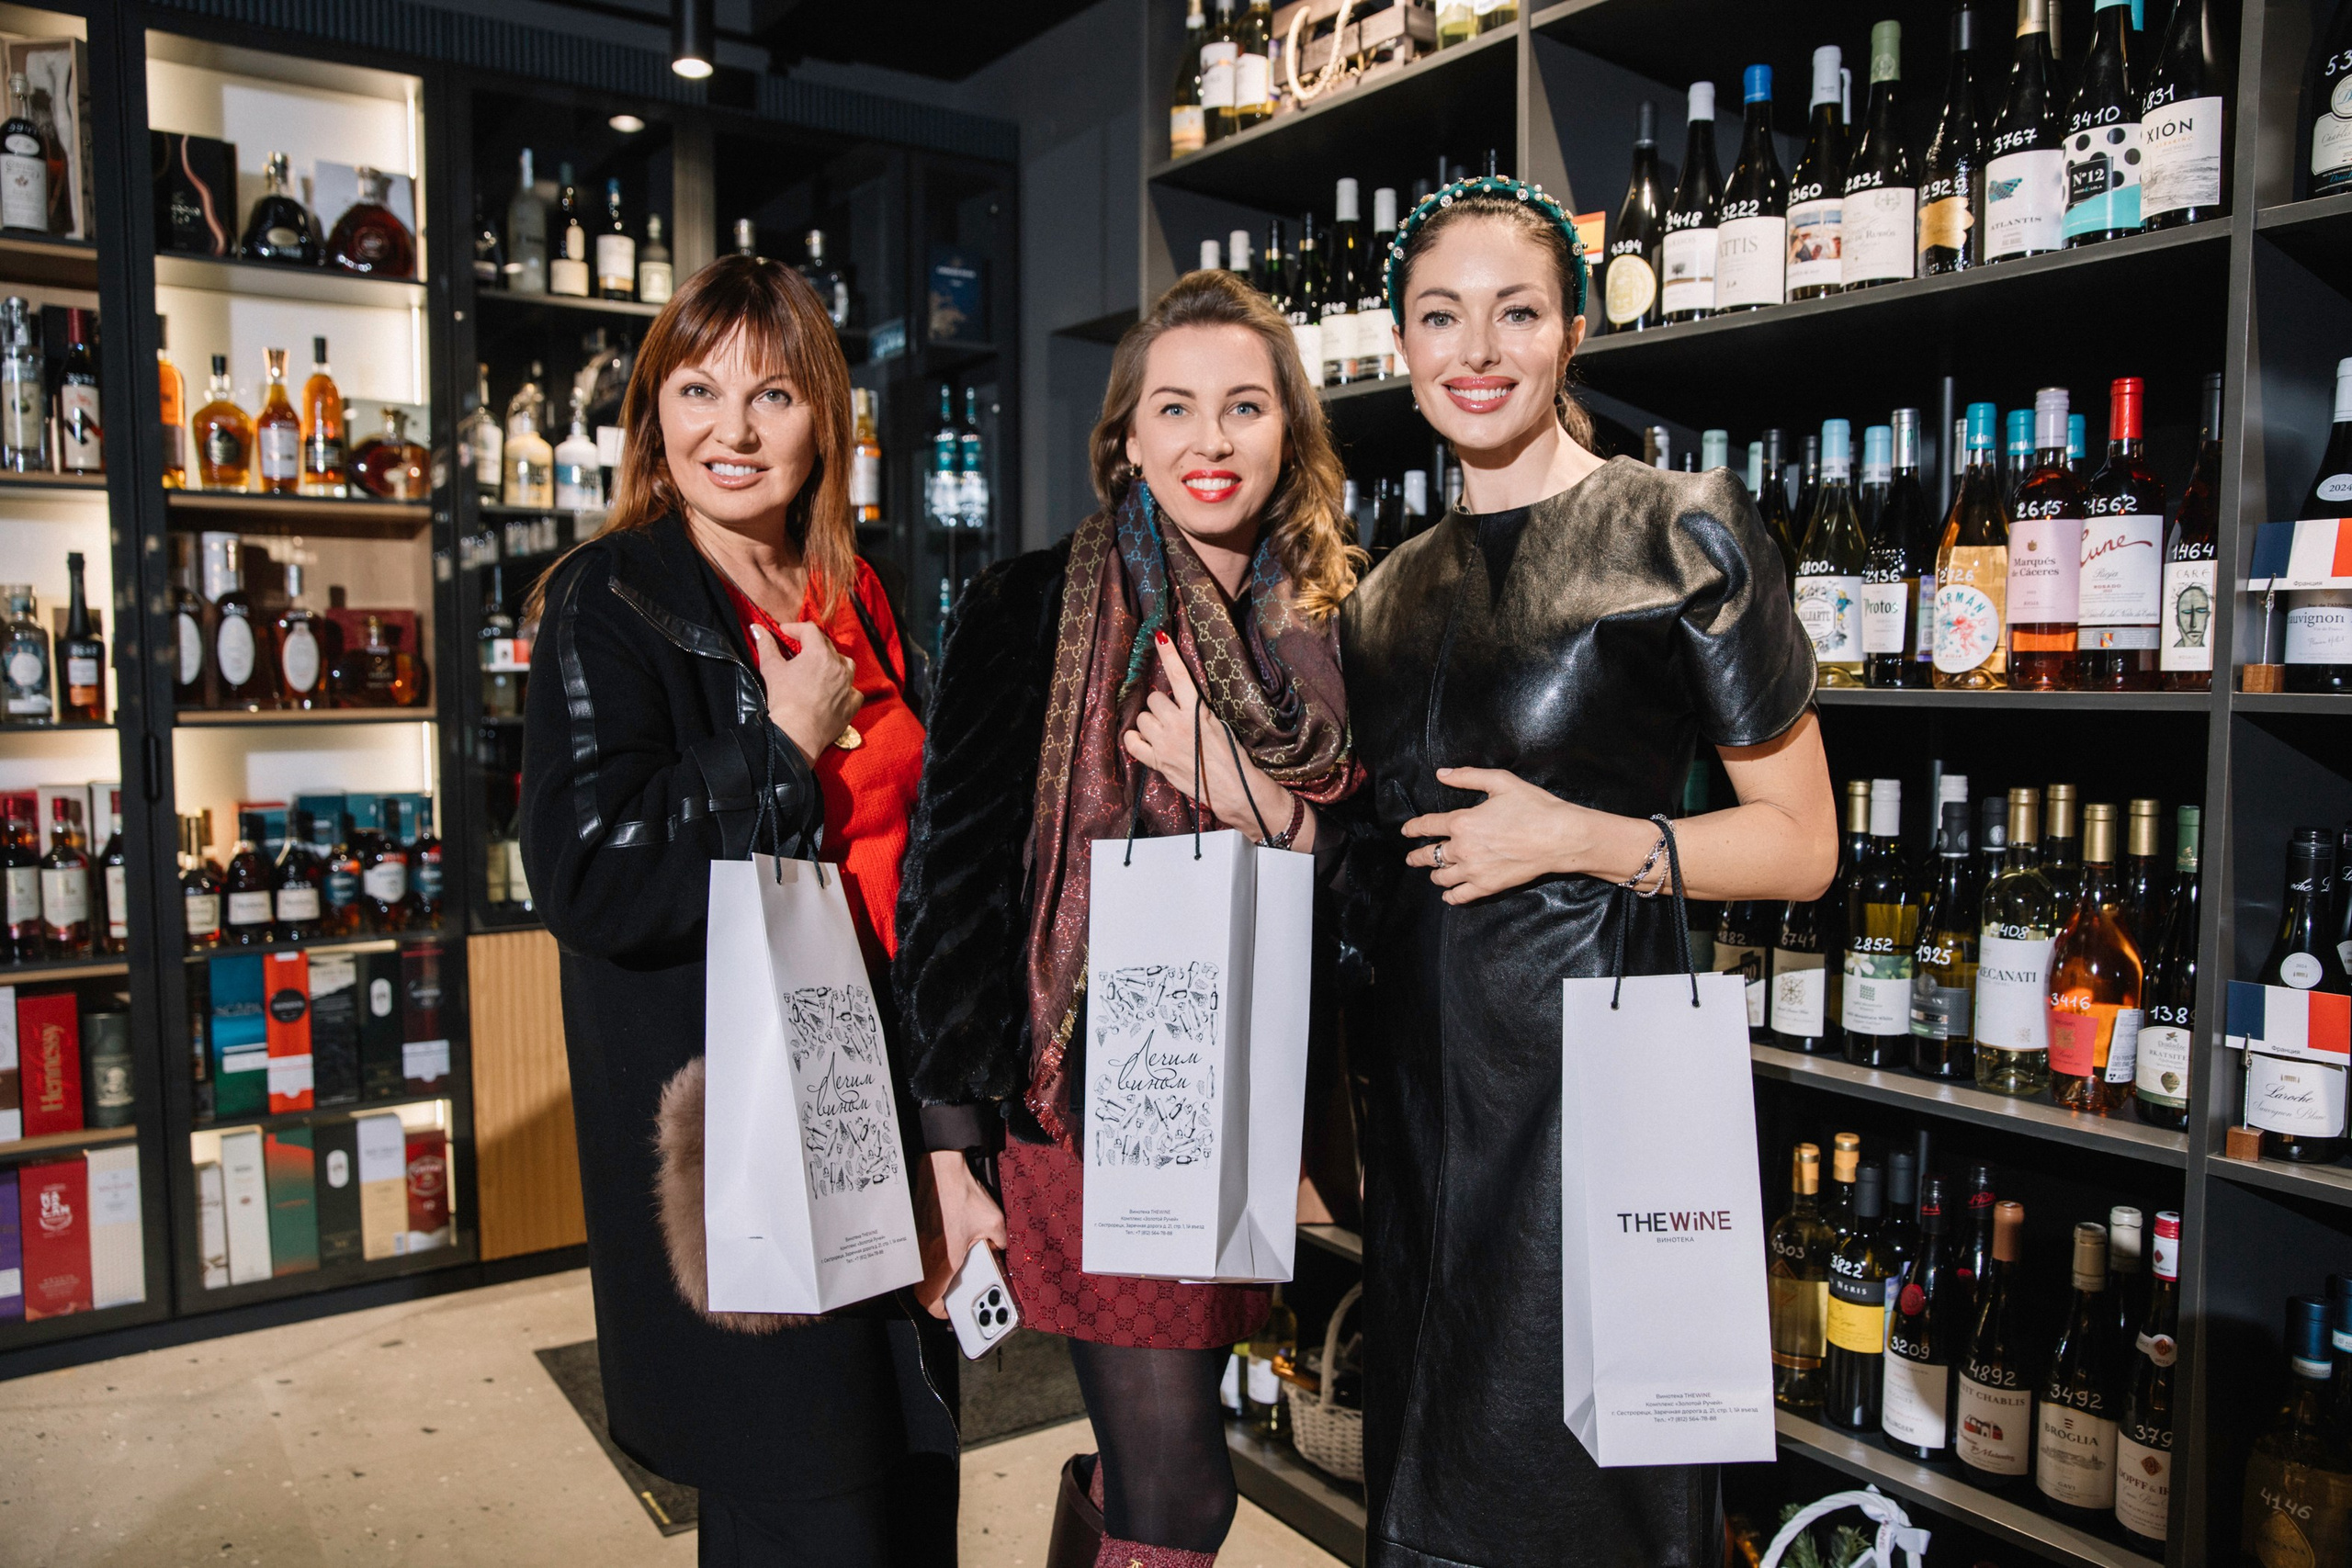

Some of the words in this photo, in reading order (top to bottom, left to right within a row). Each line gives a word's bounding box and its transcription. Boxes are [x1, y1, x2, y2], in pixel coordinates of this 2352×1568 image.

[2069, 106, 2120, 131] 3410
[1993, 128, 2038, 155] 3767
[2146, 118, 2193, 145] XIÓN
[1844, 171, 1883, 194] 2831
[1720, 198, 1759, 222] 3222
[1665, 211, 1702, 232] 2418
[1990, 217, 2042, 231] ATLANTIS
[1611, 239, 1643, 256] 4394
[2016, 500, 2063, 519] 2615
[2087, 495, 2138, 515] 1562
[2172, 542, 2214, 560] 1464
[2014, 557, 2056, 568] Marqués
[2019, 567, 2060, 577] Cáceres
[1865, 569, 1901, 583] 2136
[2176, 568, 2211, 579] CARE
[1863, 598, 1898, 617] Protos
[1781, 932, 1817, 948] 6741
[1854, 936, 1894, 952] 2852
[1916, 944, 1953, 965] 1925
[2050, 992, 2091, 1010] 3416
[1108, 1029, 1203, 1081] Лечим
[2271, 1045, 2301, 1055] Франция
[807, 1052, 876, 1103] Лечим
[1117, 1053, 1192, 1091] вином
[817, 1077, 872, 1117] вином
[2264, 1083, 2316, 1103] Laroche
[2253, 1100, 2292, 1120] Sauvignon
[2297, 1106, 2326, 1121] Blanc
[1771, 1237, 1805, 1259] 4303
[1829, 1255, 1864, 1279] 3822
[1837, 1280, 1868, 1295] NERIS
[1890, 1336, 1930, 1359] 3209
[1969, 1359, 2017, 1387] 4892
[1976, 1391, 2026, 1406] CHABLIS
[2050, 1383, 2103, 1410] 3492
[2044, 1422, 2098, 1447] BROGLIA
[2057, 1481, 2076, 1492] GAVI
[2260, 1487, 2313, 1519] 4146
